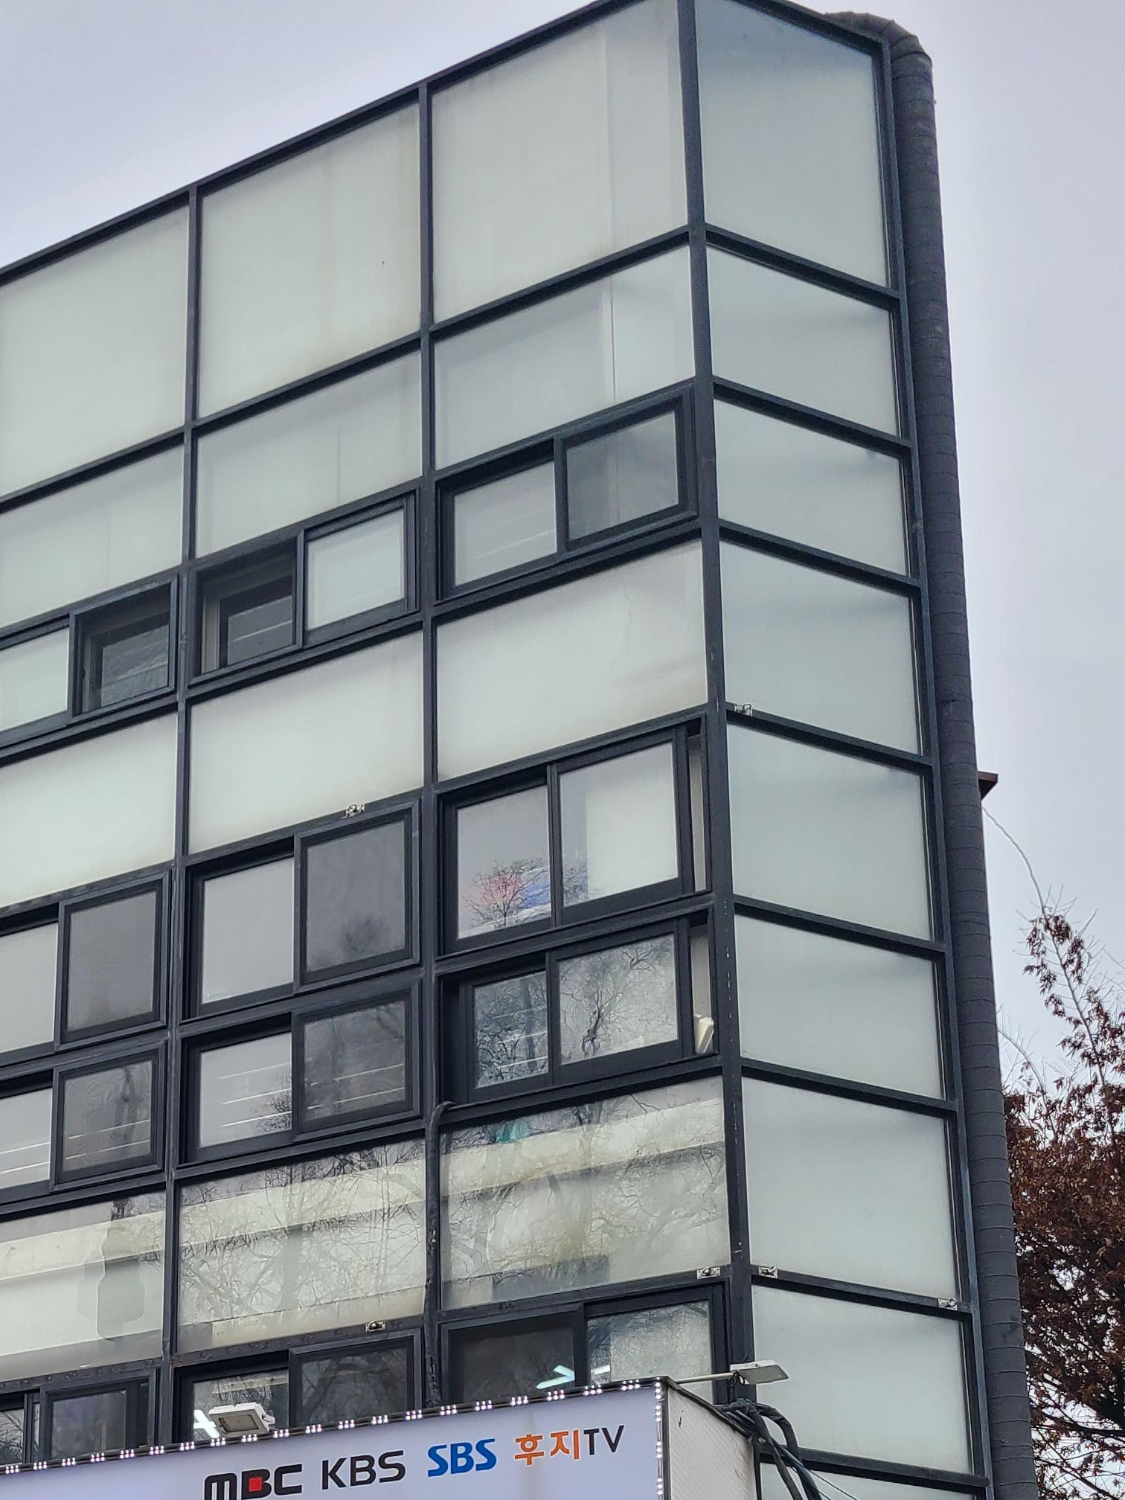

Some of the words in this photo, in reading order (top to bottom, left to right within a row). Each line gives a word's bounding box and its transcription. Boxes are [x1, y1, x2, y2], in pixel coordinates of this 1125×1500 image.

[321, 1450, 406, 1490] KBS
[427, 1438, 497, 1478] SBS
[513, 1424, 626, 1466] 후지TV
